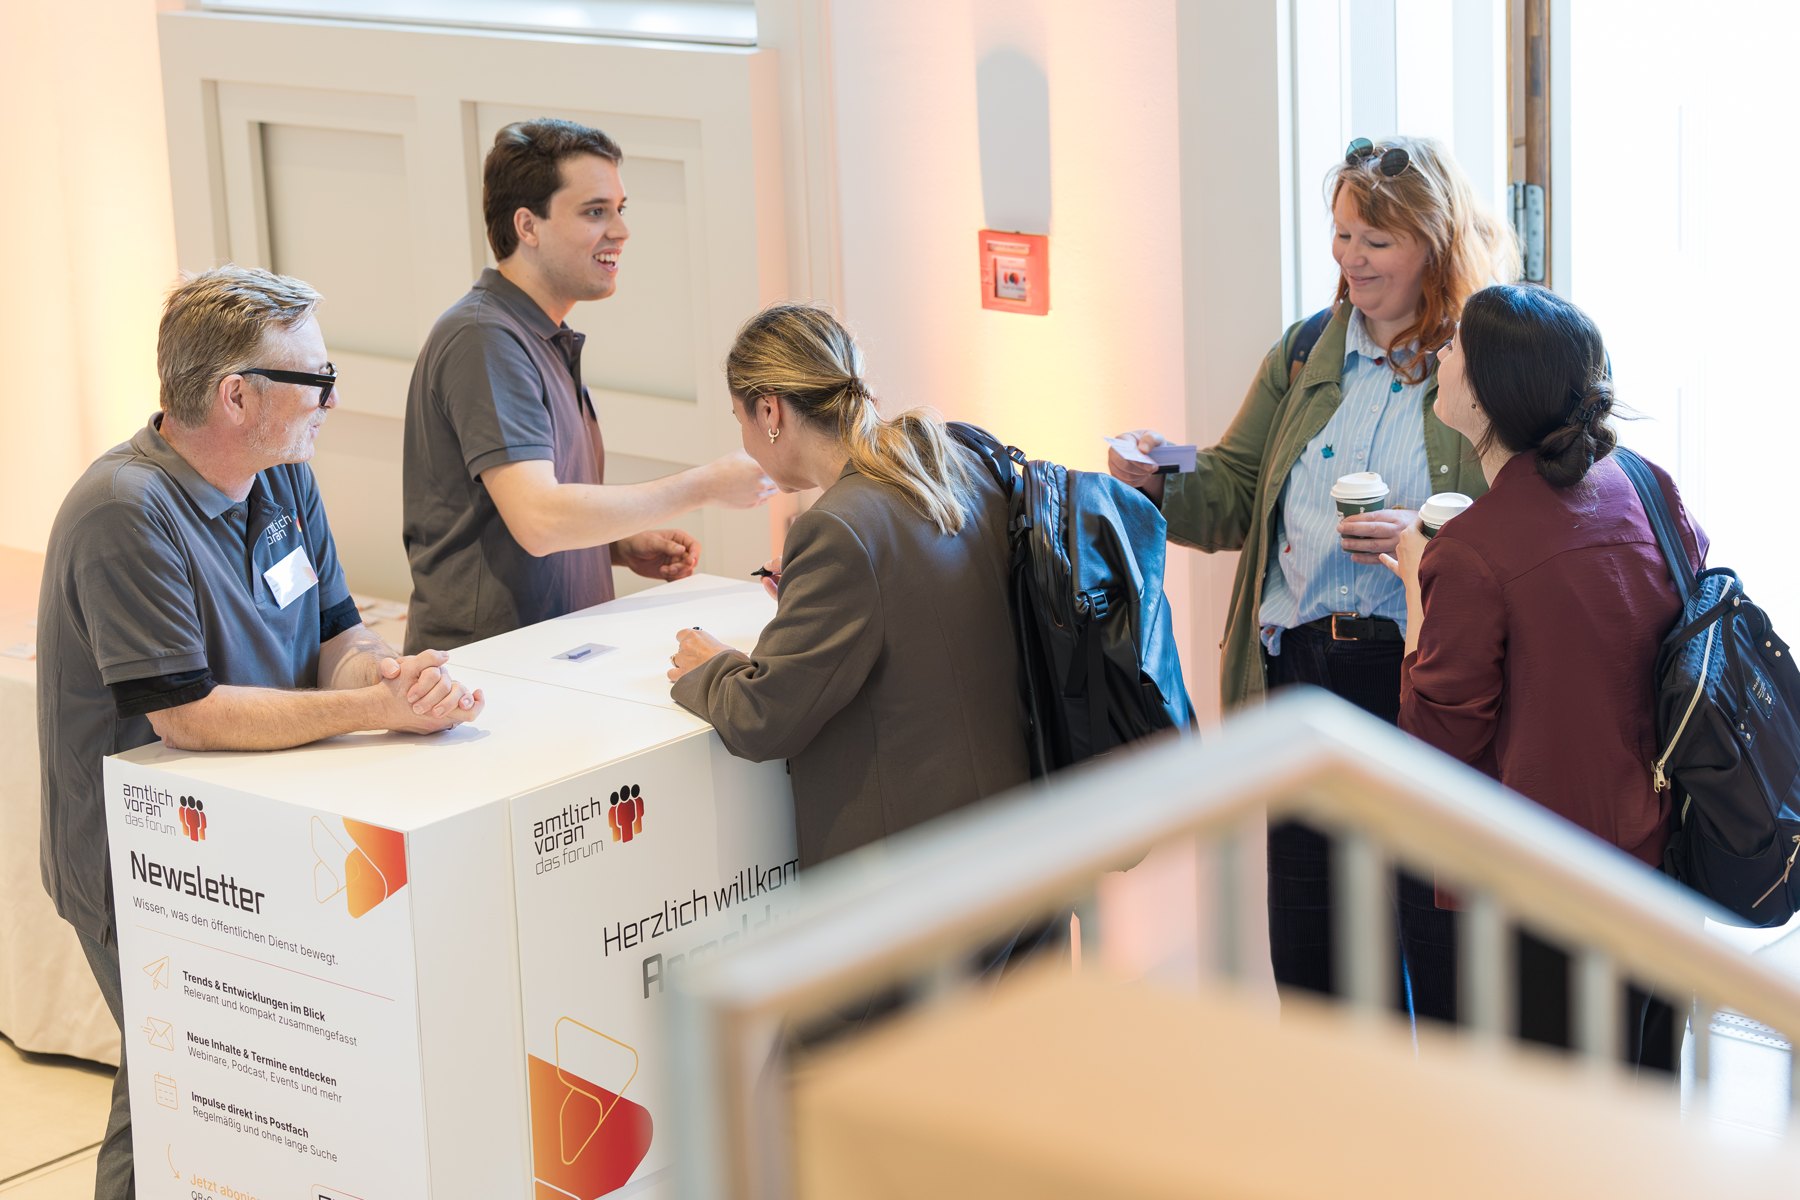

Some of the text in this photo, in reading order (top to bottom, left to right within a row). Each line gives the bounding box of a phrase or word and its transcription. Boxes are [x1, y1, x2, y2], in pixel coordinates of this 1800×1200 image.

[123, 783, 173, 807] amtlich
[124, 797, 161, 818] voran
[533, 796, 601, 838] amtlich
[125, 812, 176, 837] das forum
[534, 825, 584, 855] voran
[130, 850, 265, 914] Newsletter
[535, 840, 604, 875] das forum
[133, 896, 339, 966] Wissen, was den öffentlichen Dienst bewegt.
[603, 889, 708, 957] Herzlich
[182, 970, 326, 1021] Trends & Entwicklungen im Blick
[183, 985, 358, 1046] Relevant und kompakt zusammengefasst
[187, 1031, 337, 1087] Neue Inhalte & Termine entdecken
[187, 1046, 342, 1103] Webinare, Podcast, Events und mehr
[191, 1091, 309, 1138] Impulse direkt ins Postfach
[193, 1105, 338, 1162] Regelmäßig und ohne lange Suche
[190, 1174, 217, 1193] Jetzt
